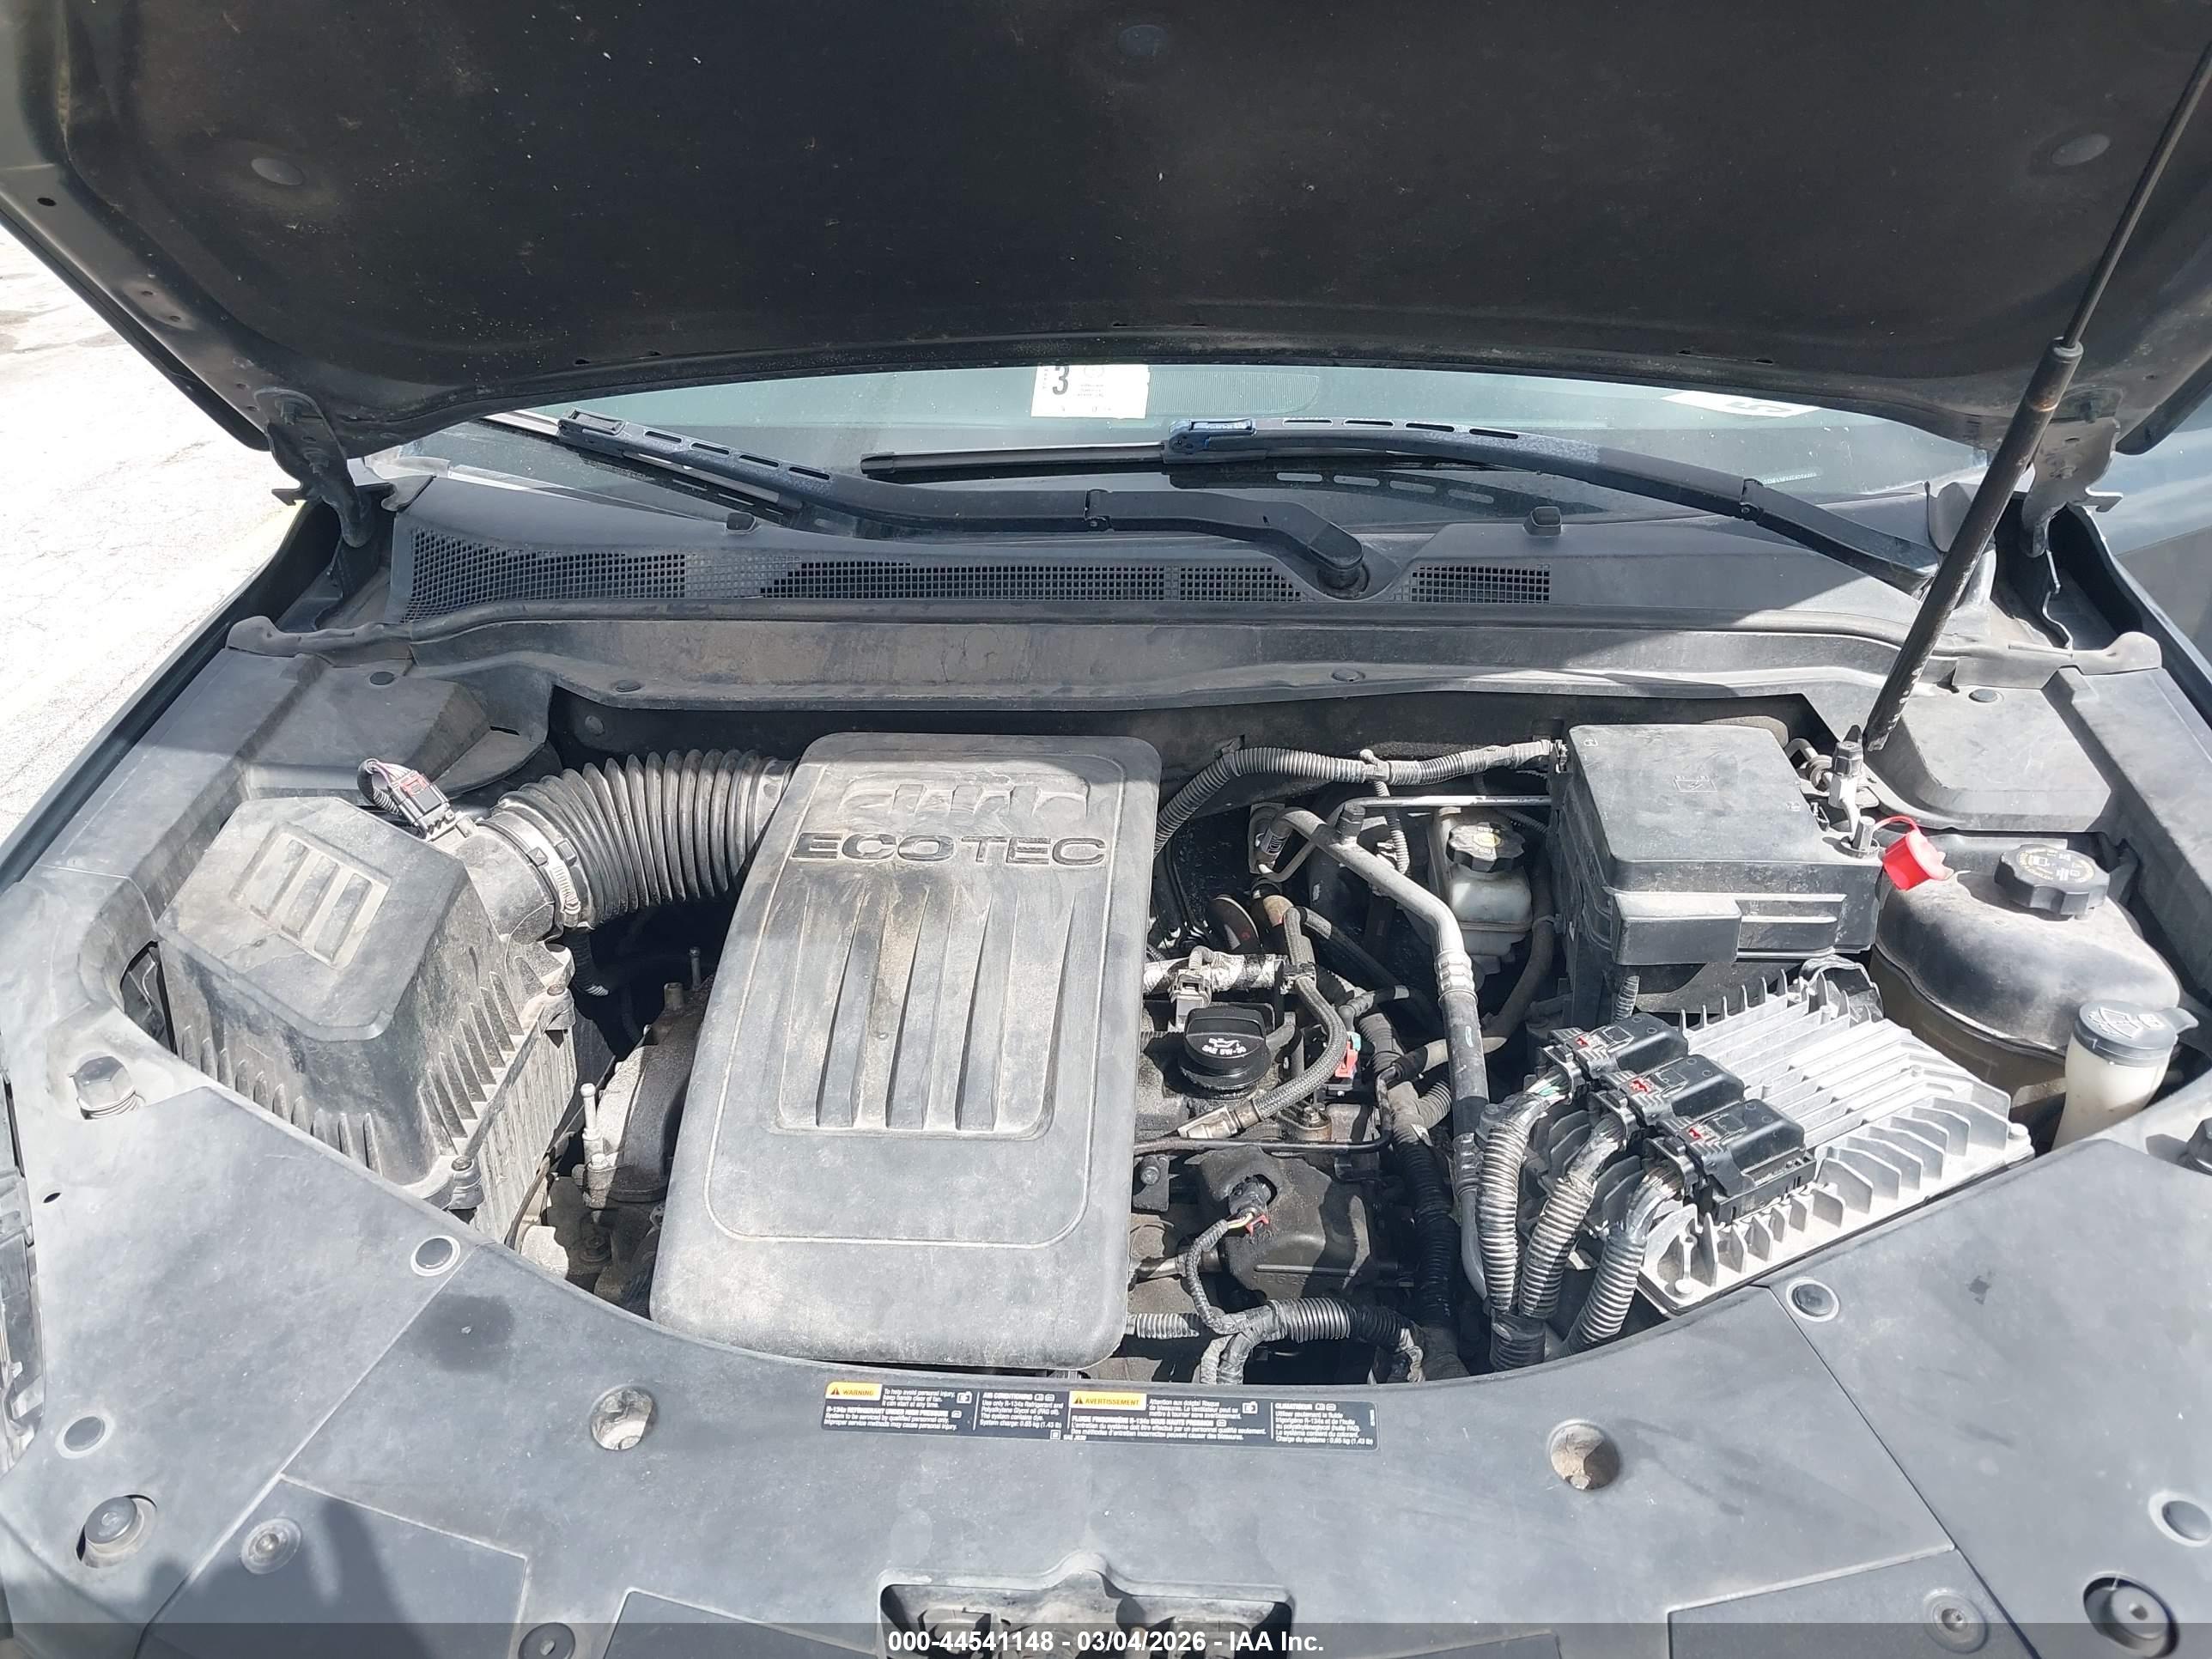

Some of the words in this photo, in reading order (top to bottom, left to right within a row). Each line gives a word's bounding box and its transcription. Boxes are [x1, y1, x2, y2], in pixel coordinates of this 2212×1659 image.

[1053, 366, 1070, 395] 3
[791, 832, 1107, 866] ECOTEC
[1201, 1045, 1218, 1054] SAE
[1219, 1046, 1247, 1055] 5W-30
